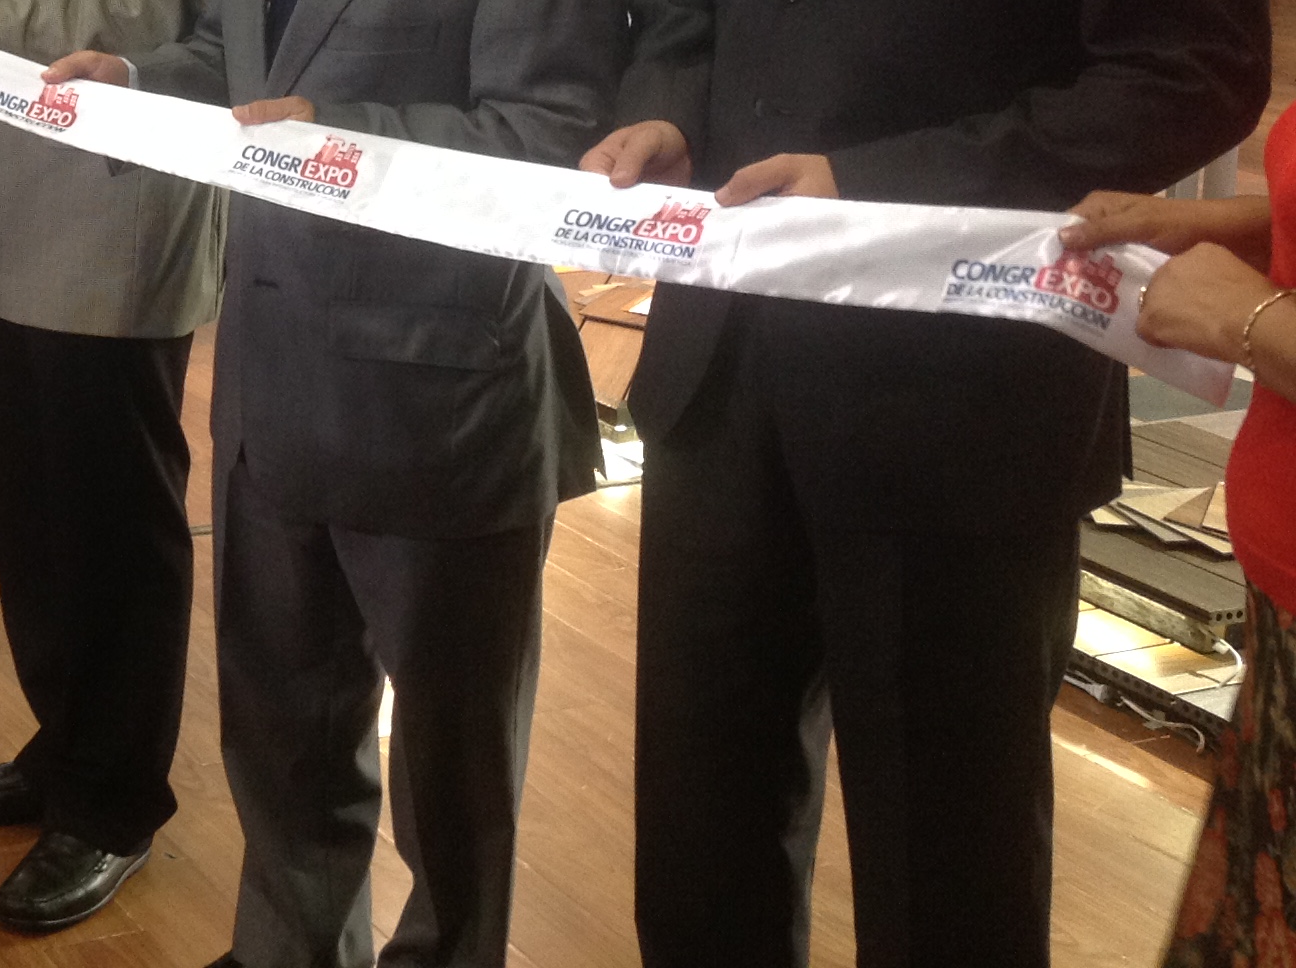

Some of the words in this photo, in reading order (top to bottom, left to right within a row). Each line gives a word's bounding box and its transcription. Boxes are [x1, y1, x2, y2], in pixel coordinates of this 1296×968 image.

[232, 160, 249, 172] DE
[249, 165, 264, 177] LA
[554, 227, 570, 239] DE
[573, 230, 590, 242] LA
[946, 283, 961, 295] DE
